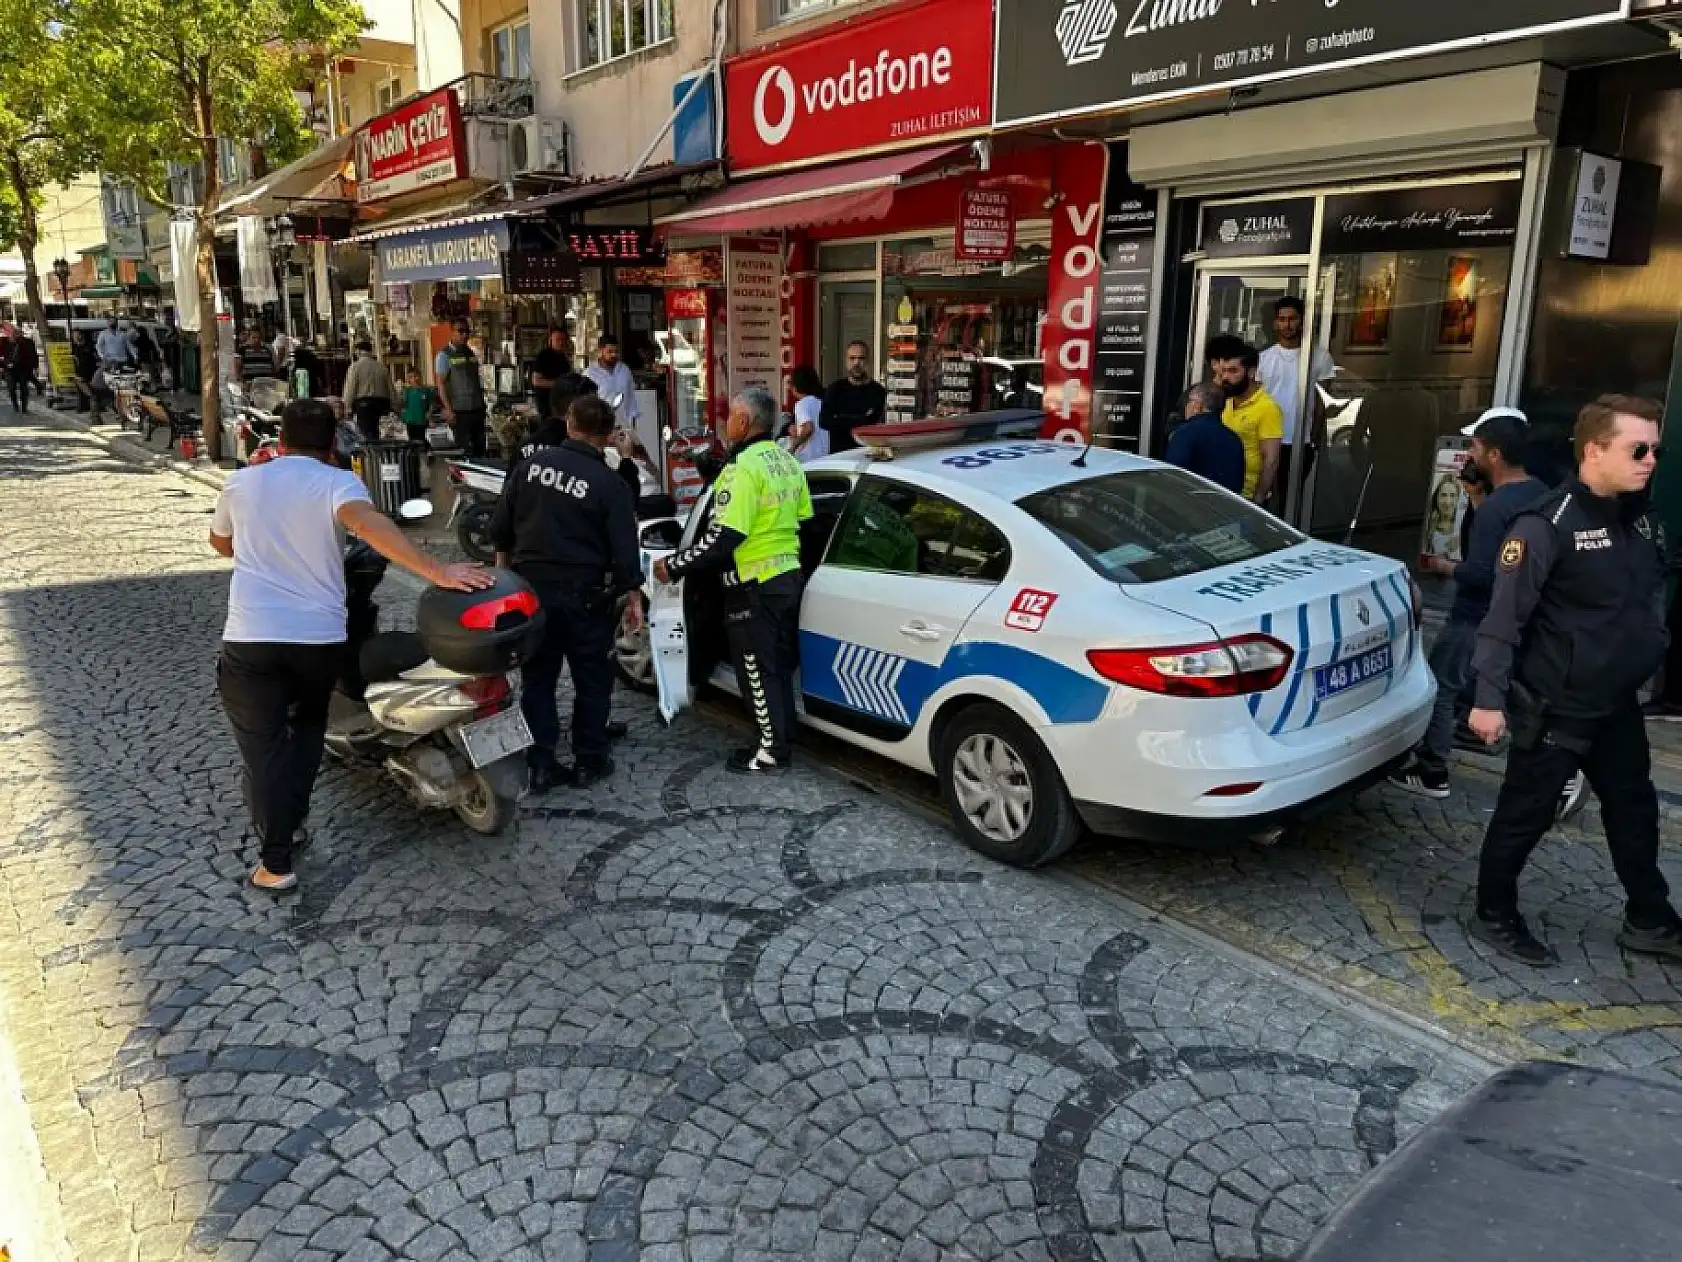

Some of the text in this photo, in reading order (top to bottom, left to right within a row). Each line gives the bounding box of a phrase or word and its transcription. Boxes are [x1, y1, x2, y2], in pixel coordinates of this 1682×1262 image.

[802, 46, 951, 114] vodafone
[890, 117, 927, 137] ZUHAL
[1243, 215, 1289, 231] ZUHAL
[1017, 593, 1050, 614] 112
[1351, 659, 1361, 681] A
